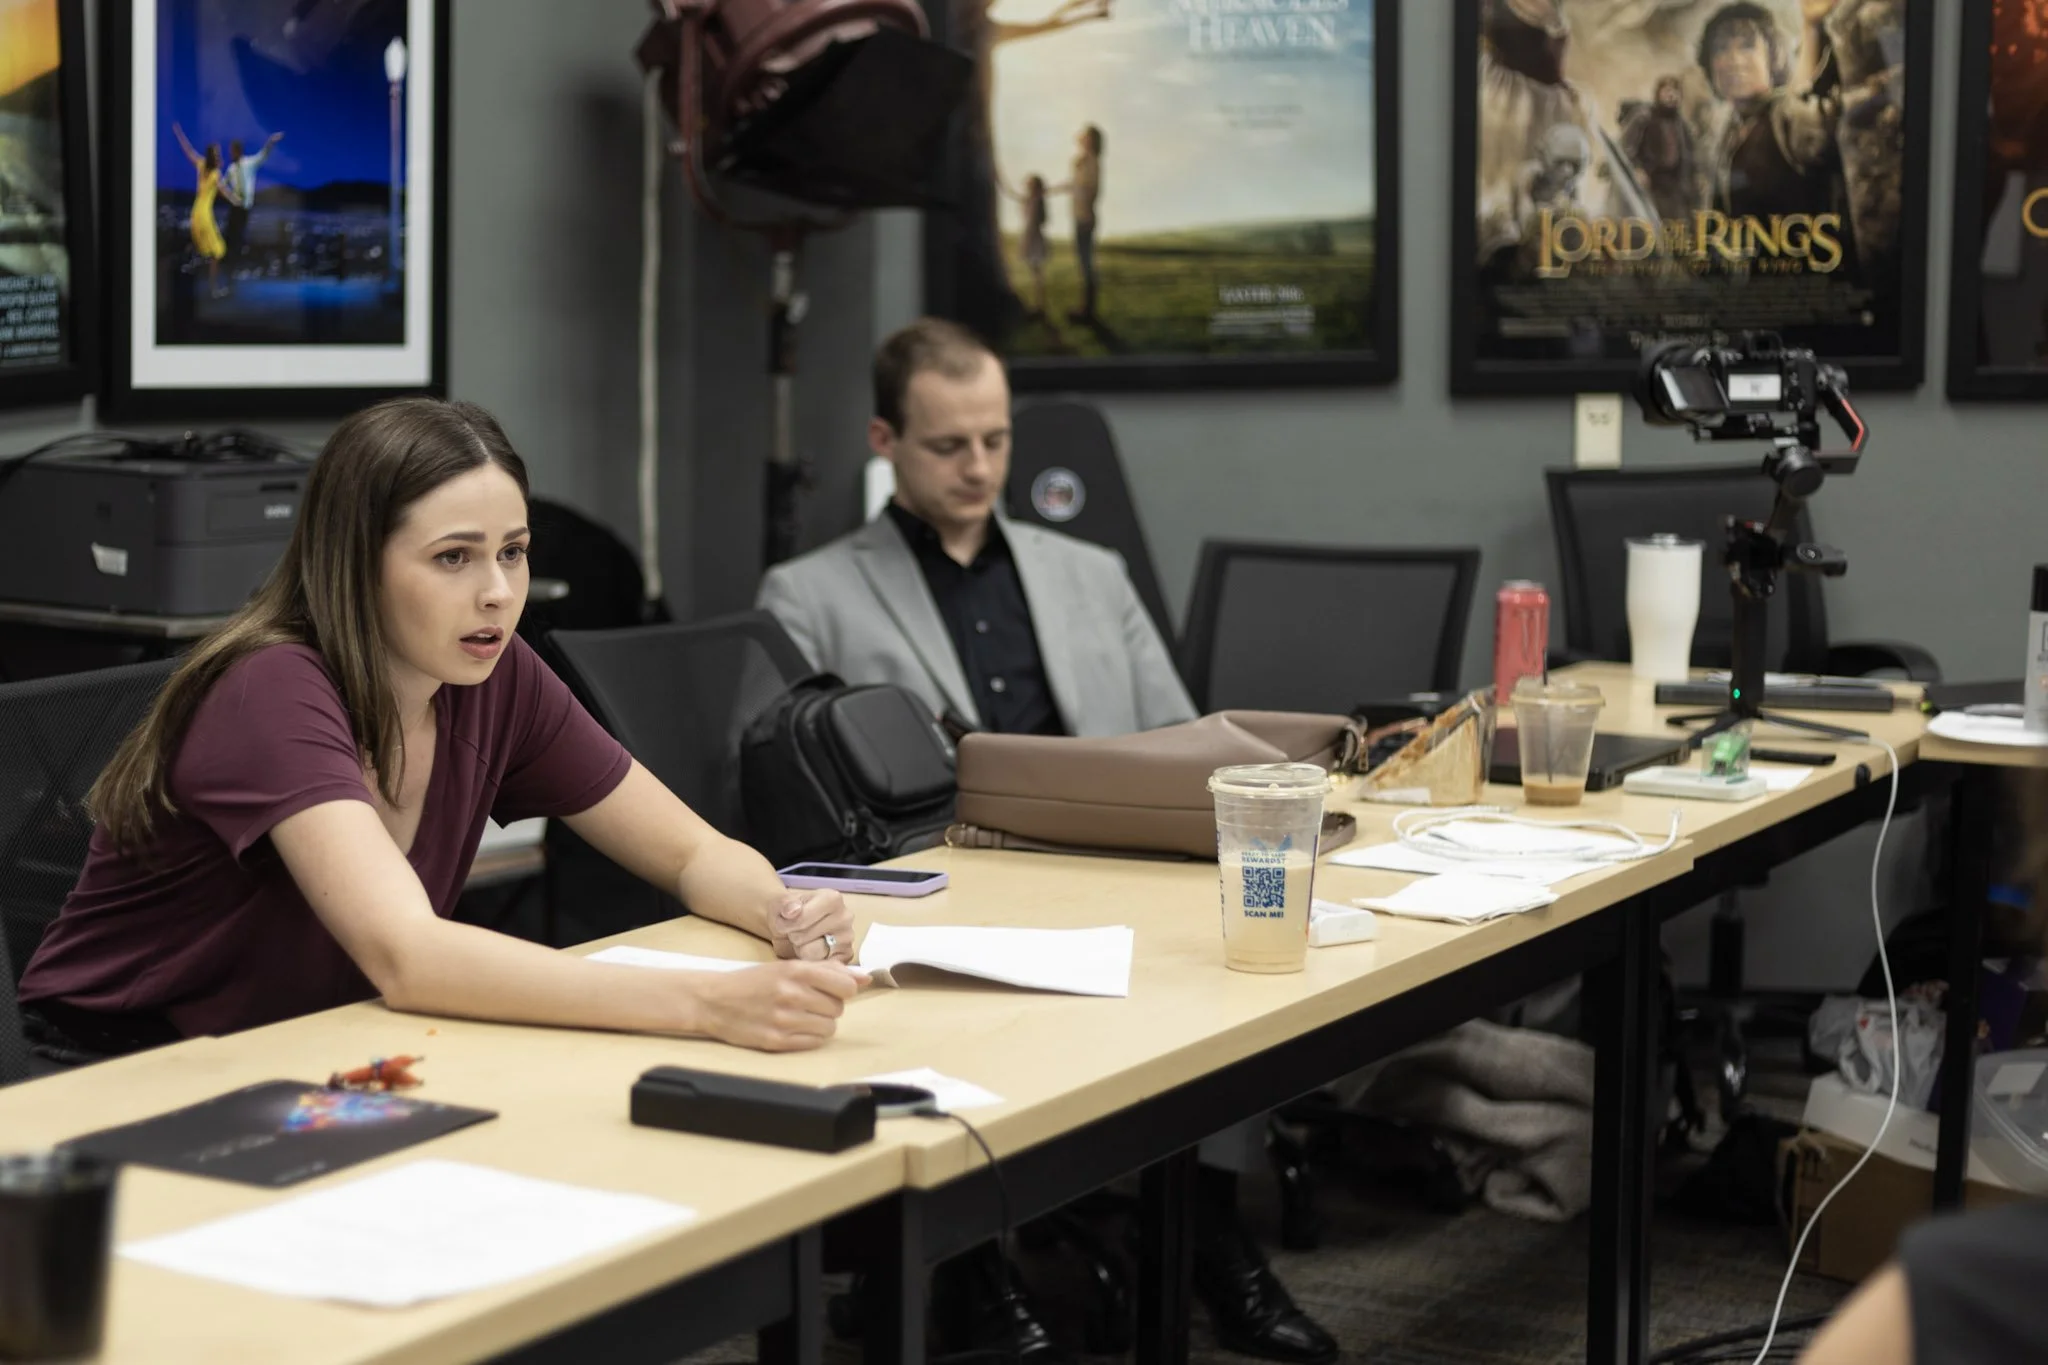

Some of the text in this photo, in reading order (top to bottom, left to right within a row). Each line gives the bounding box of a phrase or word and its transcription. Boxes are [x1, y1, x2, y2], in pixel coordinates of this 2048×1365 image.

[1189, 15, 1336, 49] HEAVEN
[1536, 208, 1656, 278] LORD
[1694, 209, 1843, 273] RINGS
[1244, 910, 1267, 918] SCAN
